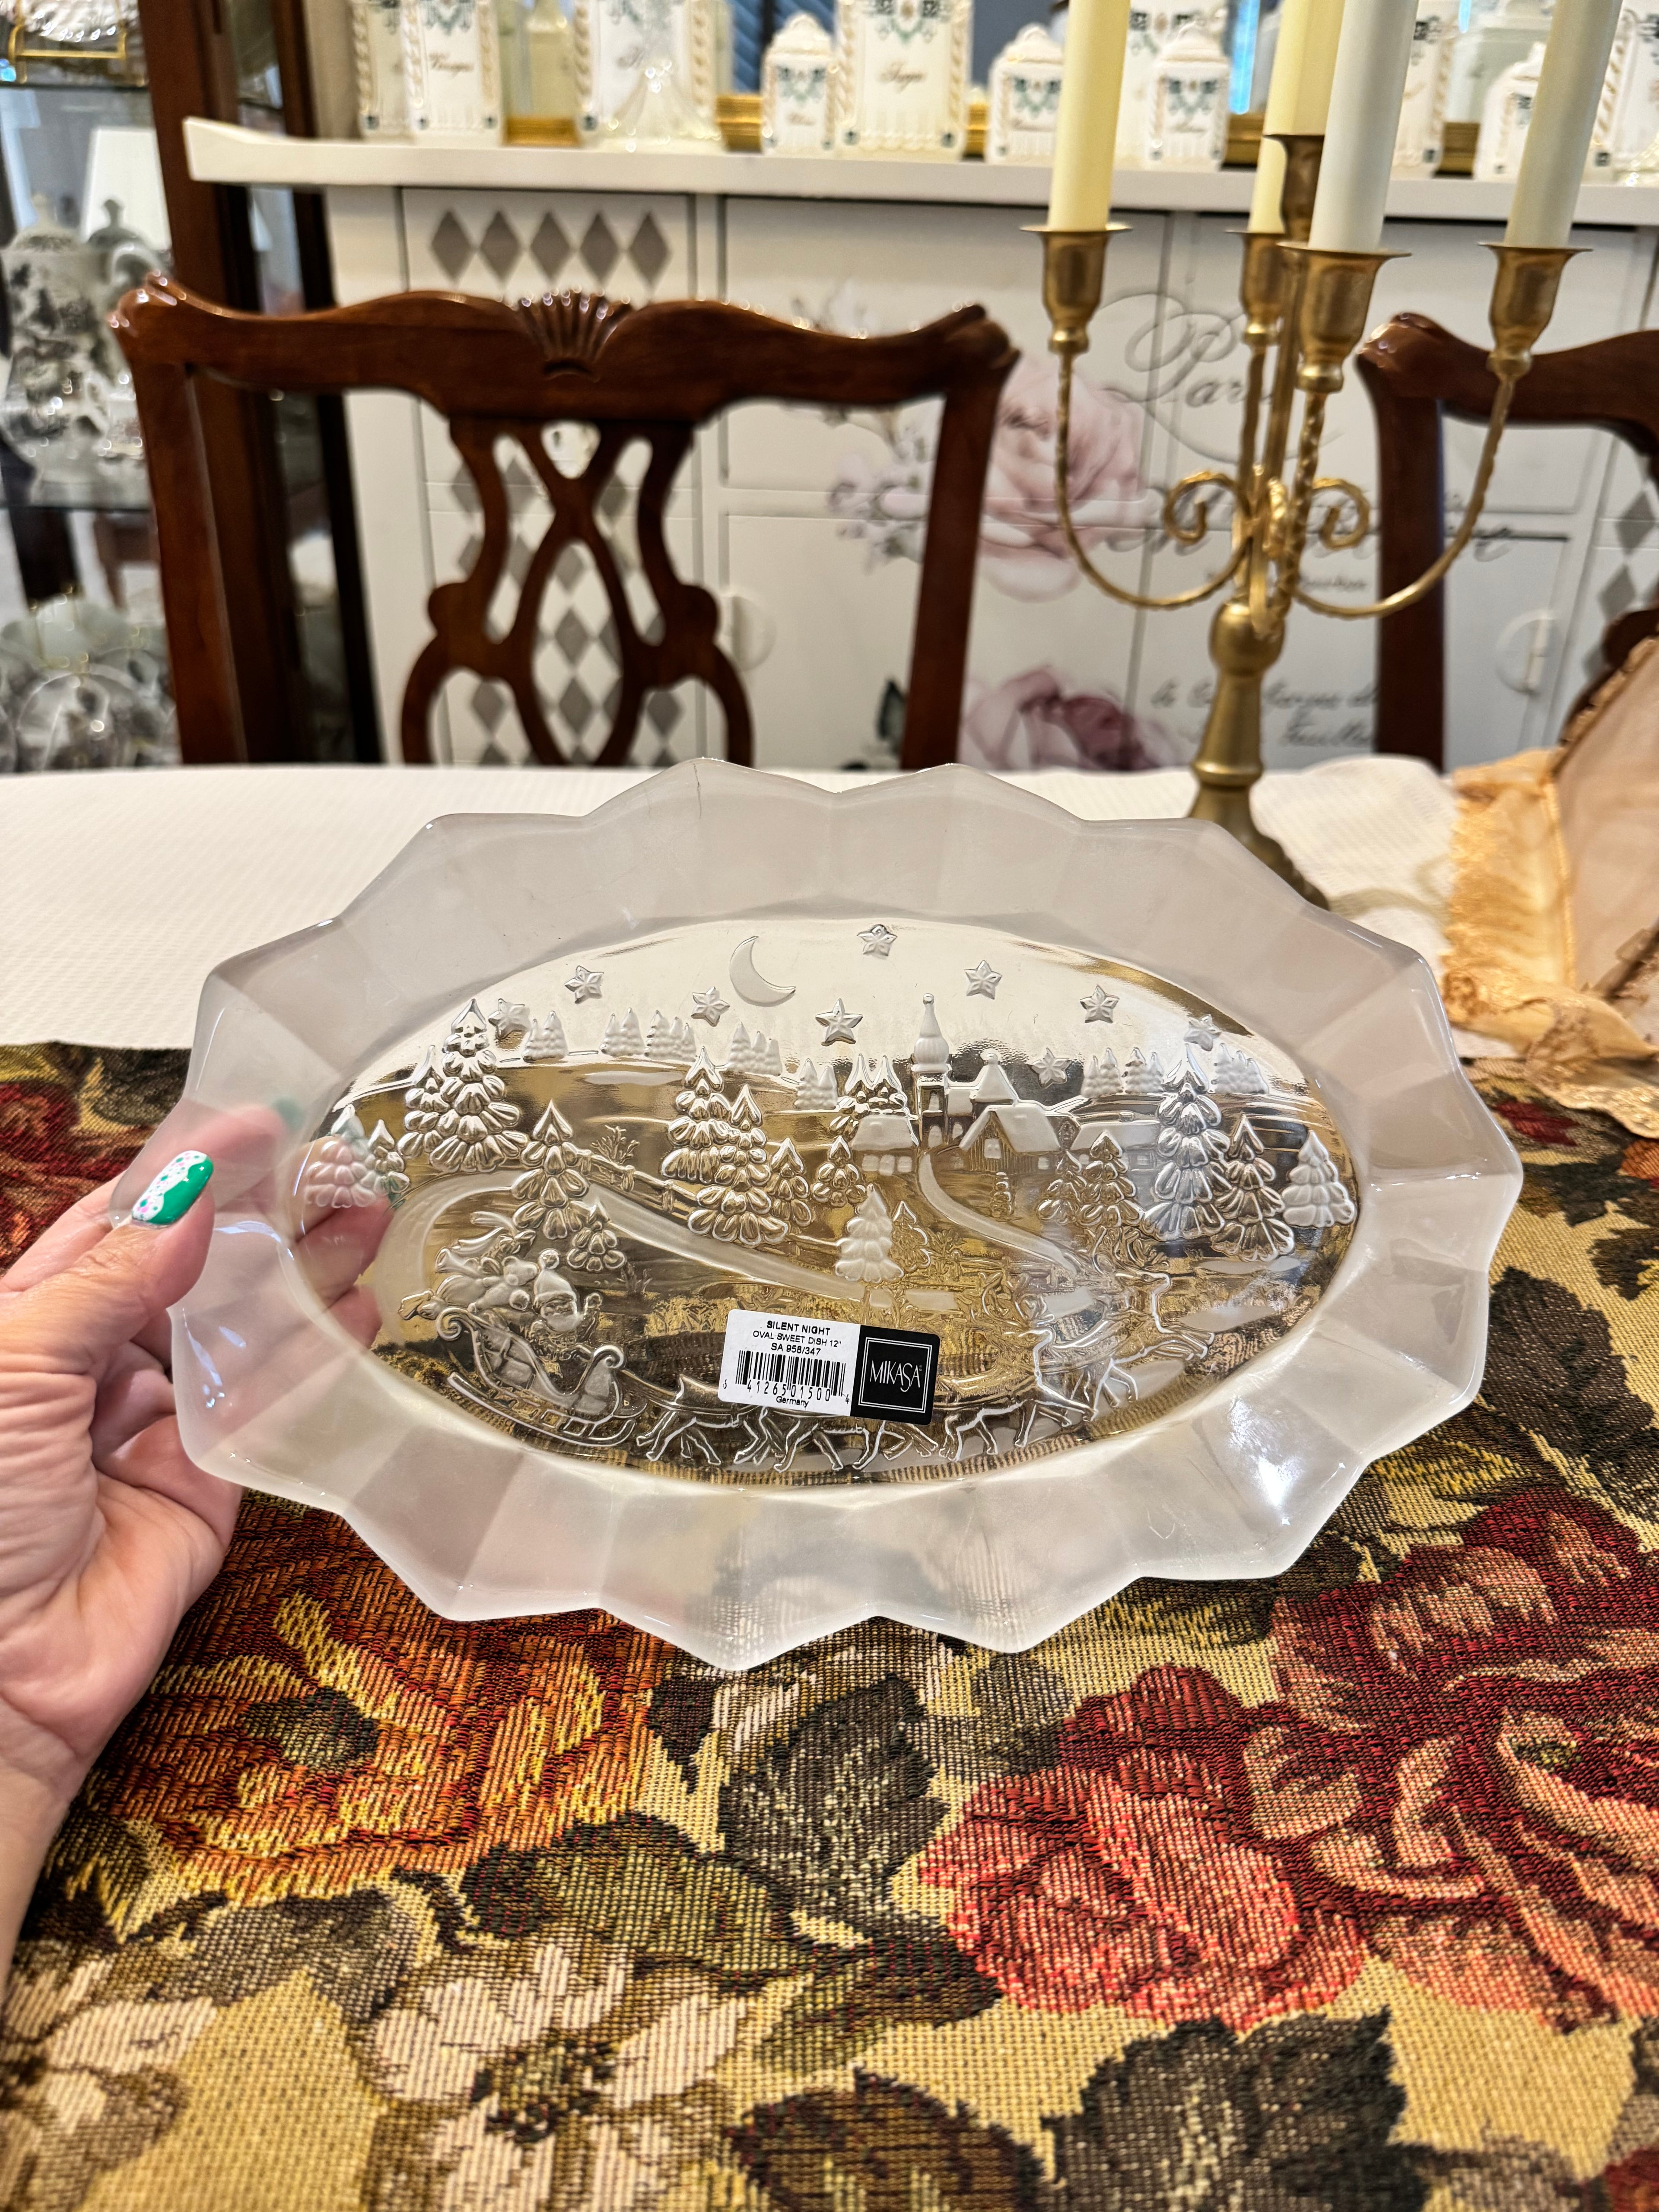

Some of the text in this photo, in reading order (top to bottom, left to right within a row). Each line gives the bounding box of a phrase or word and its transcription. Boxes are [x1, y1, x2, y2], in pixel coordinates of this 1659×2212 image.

[766, 1320, 831, 1336] SILENT NIGHT
[753, 1330, 774, 1339] OVAL
[777, 1333, 805, 1344] SWEET
[808, 1337, 827, 1346] DISH
[771, 1342, 821, 1356] SA 958/347
[870, 1360, 920, 1392] MIKASA
